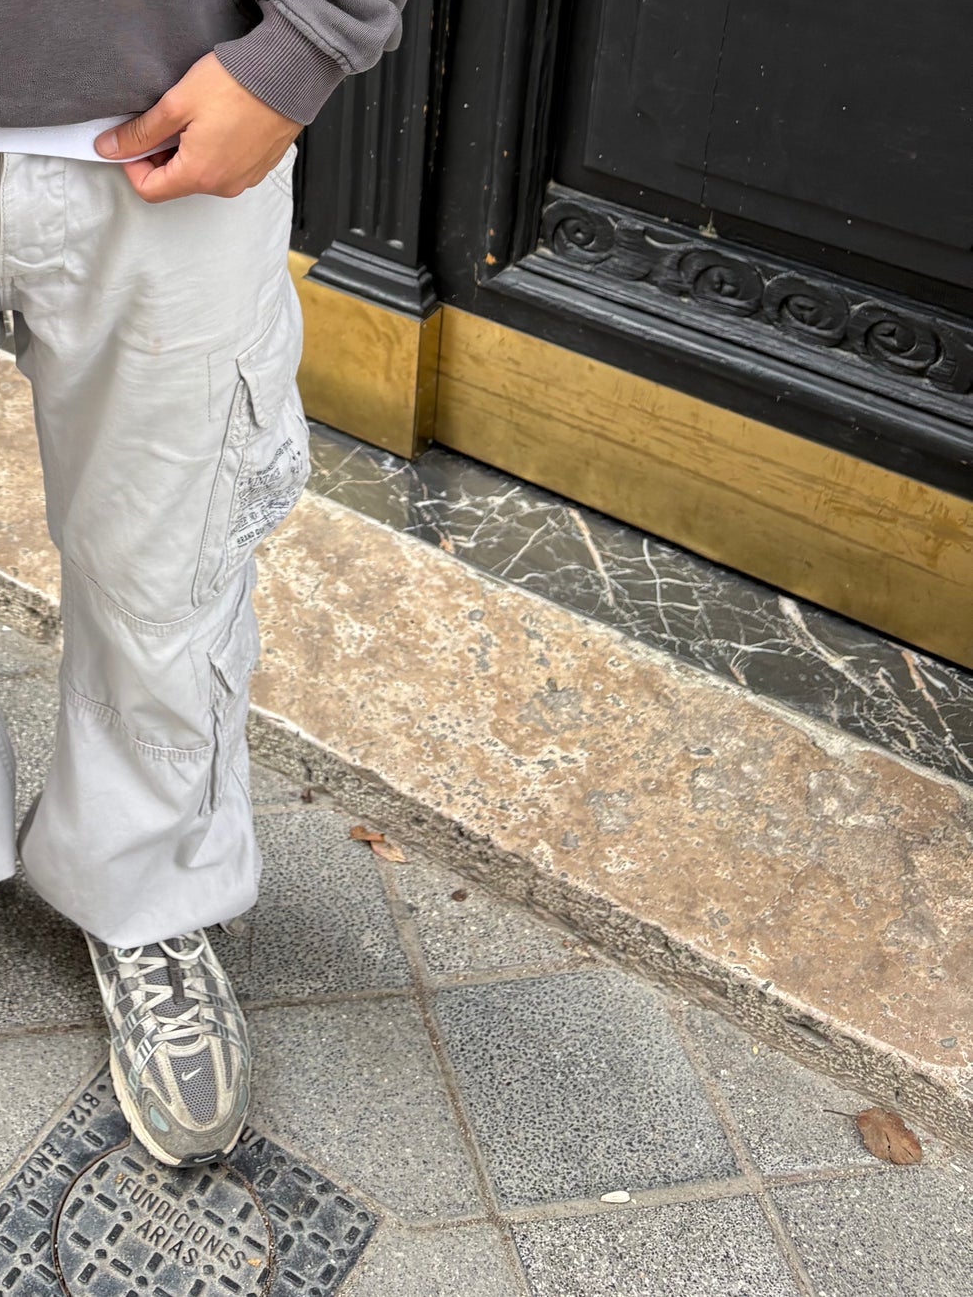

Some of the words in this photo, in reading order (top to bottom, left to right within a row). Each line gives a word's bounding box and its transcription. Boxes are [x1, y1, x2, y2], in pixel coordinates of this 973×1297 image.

[59, 1091, 99, 1142] B125
[240, 1126, 267, 1155] UA
[7, 1141, 63, 1200] EN124
[118, 1177, 247, 1271] FUNDICIONES
[135, 1219, 199, 1267] ARIAS
